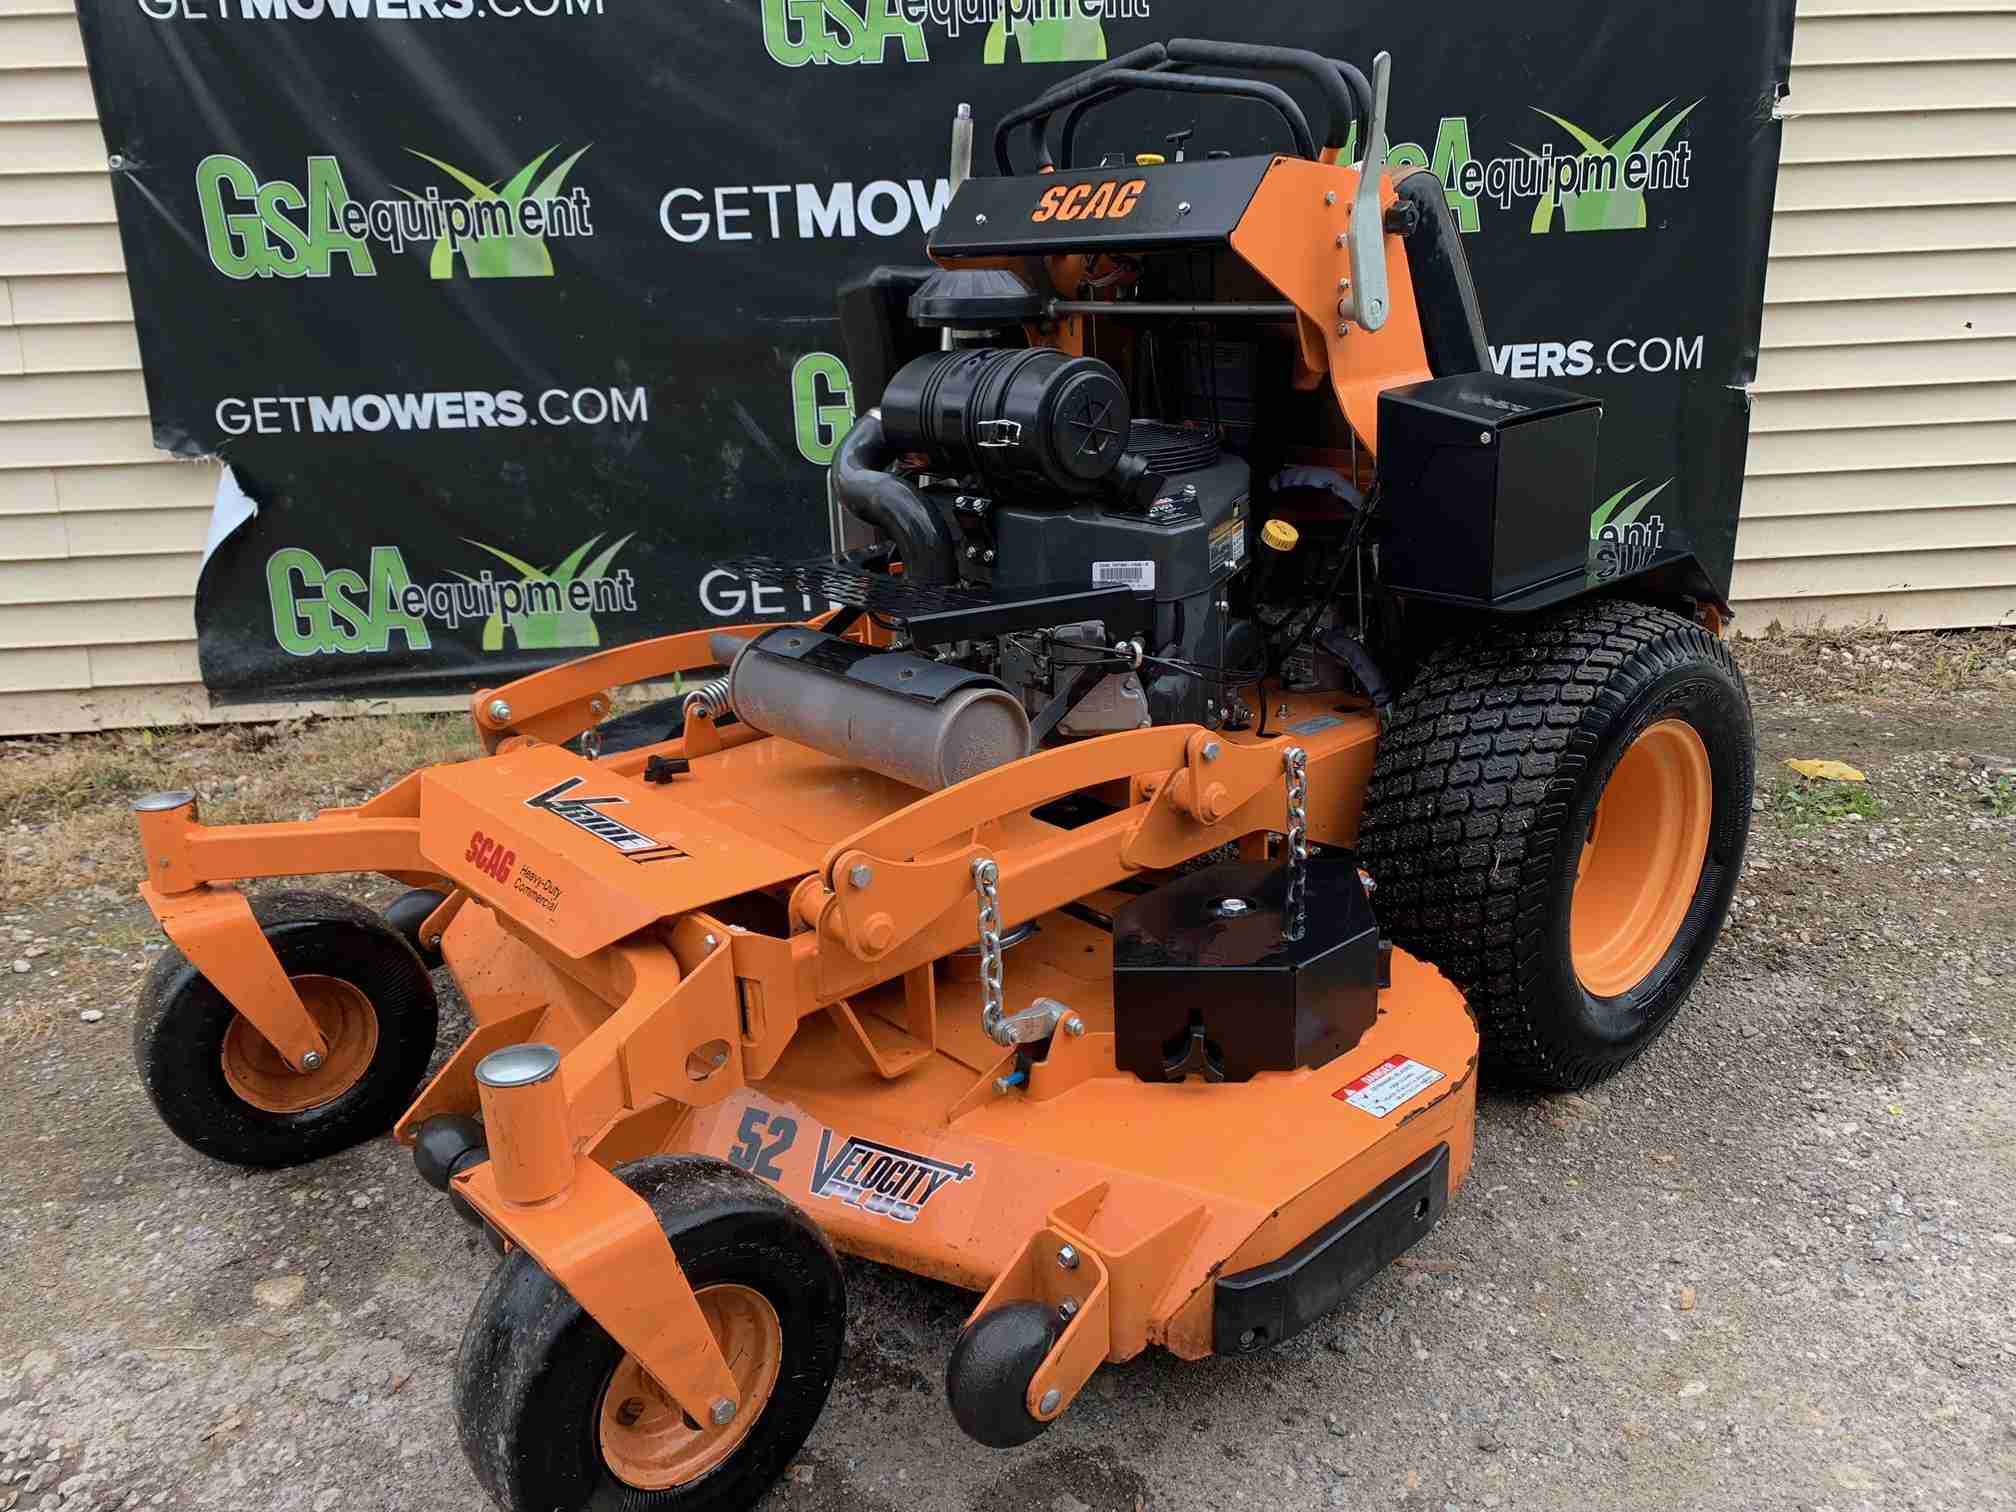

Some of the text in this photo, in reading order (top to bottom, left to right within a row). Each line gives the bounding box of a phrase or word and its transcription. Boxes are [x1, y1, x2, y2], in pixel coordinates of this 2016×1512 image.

[1031, 178, 1147, 223] SCAG
[1458, 141, 1691, 209] equipment
[343, 187, 594, 253] equipment
[214, 386, 649, 435] GETMOWERS.COM
[1590, 515, 1664, 549] ent
[398, 568, 638, 629] equipment
[465, 830, 516, 884] SCAG
[519, 864, 562, 901] Heavy-Duty
[512, 877, 561, 913] Commercial
[728, 1106, 798, 1181] 52
